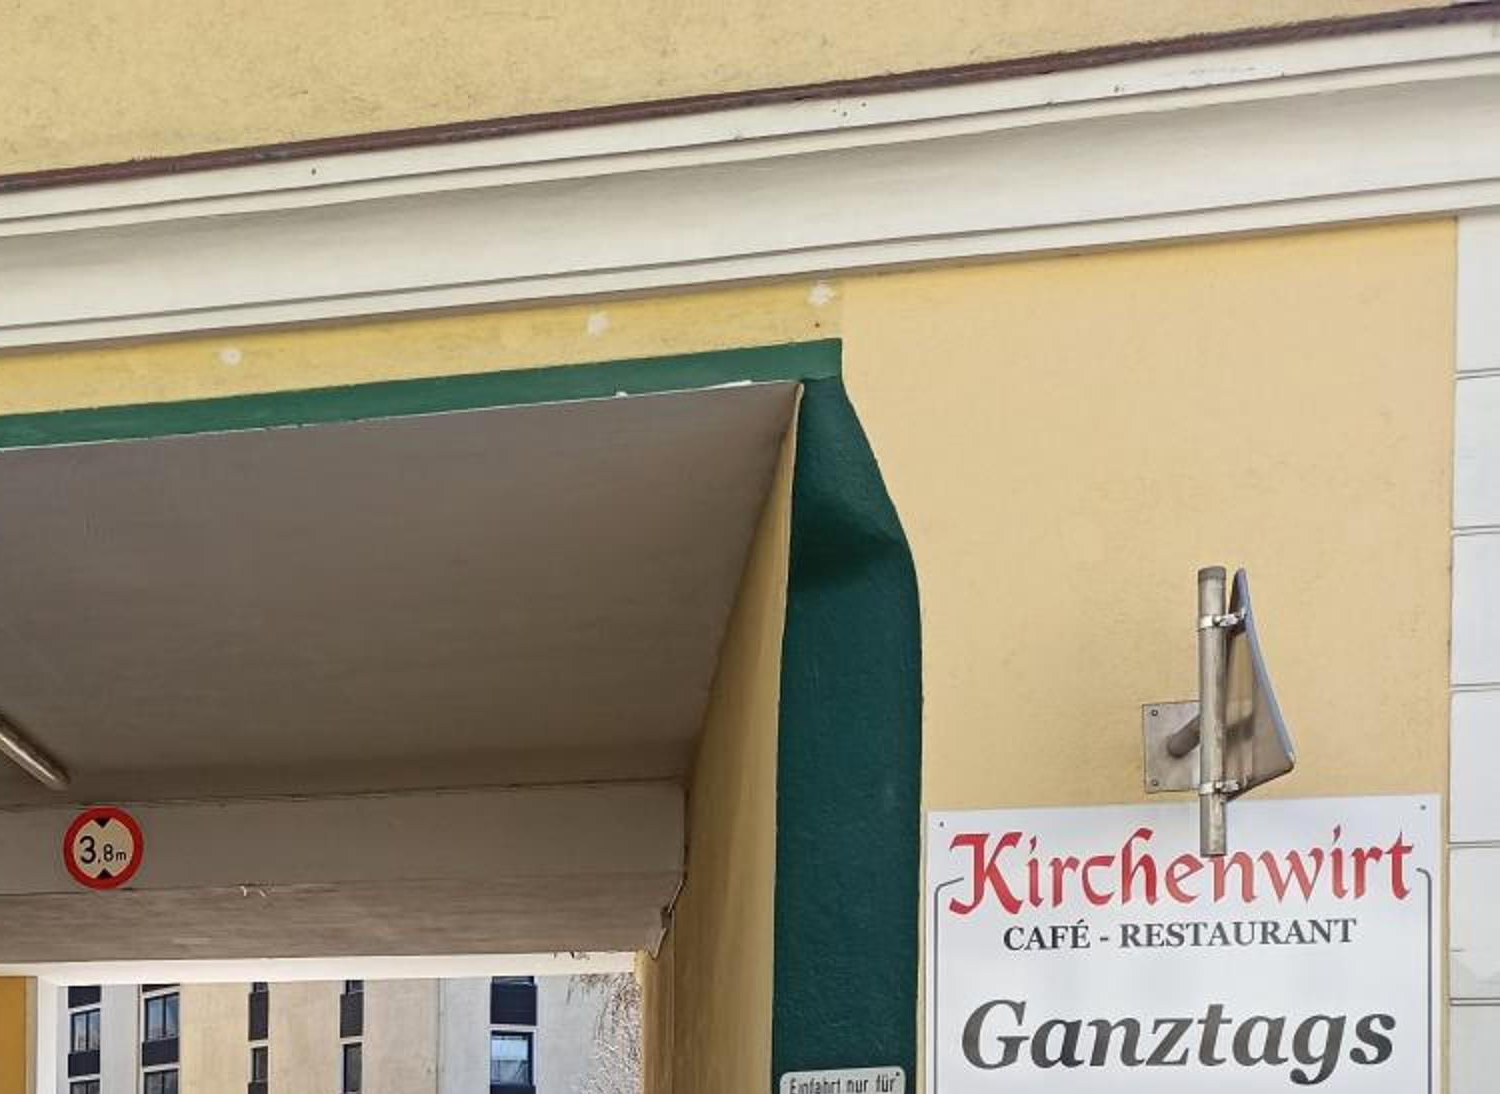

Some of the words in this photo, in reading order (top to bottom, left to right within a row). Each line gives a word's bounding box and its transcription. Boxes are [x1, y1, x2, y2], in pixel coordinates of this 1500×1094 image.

[948, 825, 1415, 916] Kirchenwirt
[1002, 918, 1091, 951] CAFÉ
[1119, 917, 1357, 949] RESTAURANT
[962, 999, 1397, 1086] Ganztags
[846, 1080, 869, 1094] nur
[876, 1075, 897, 1094] für
